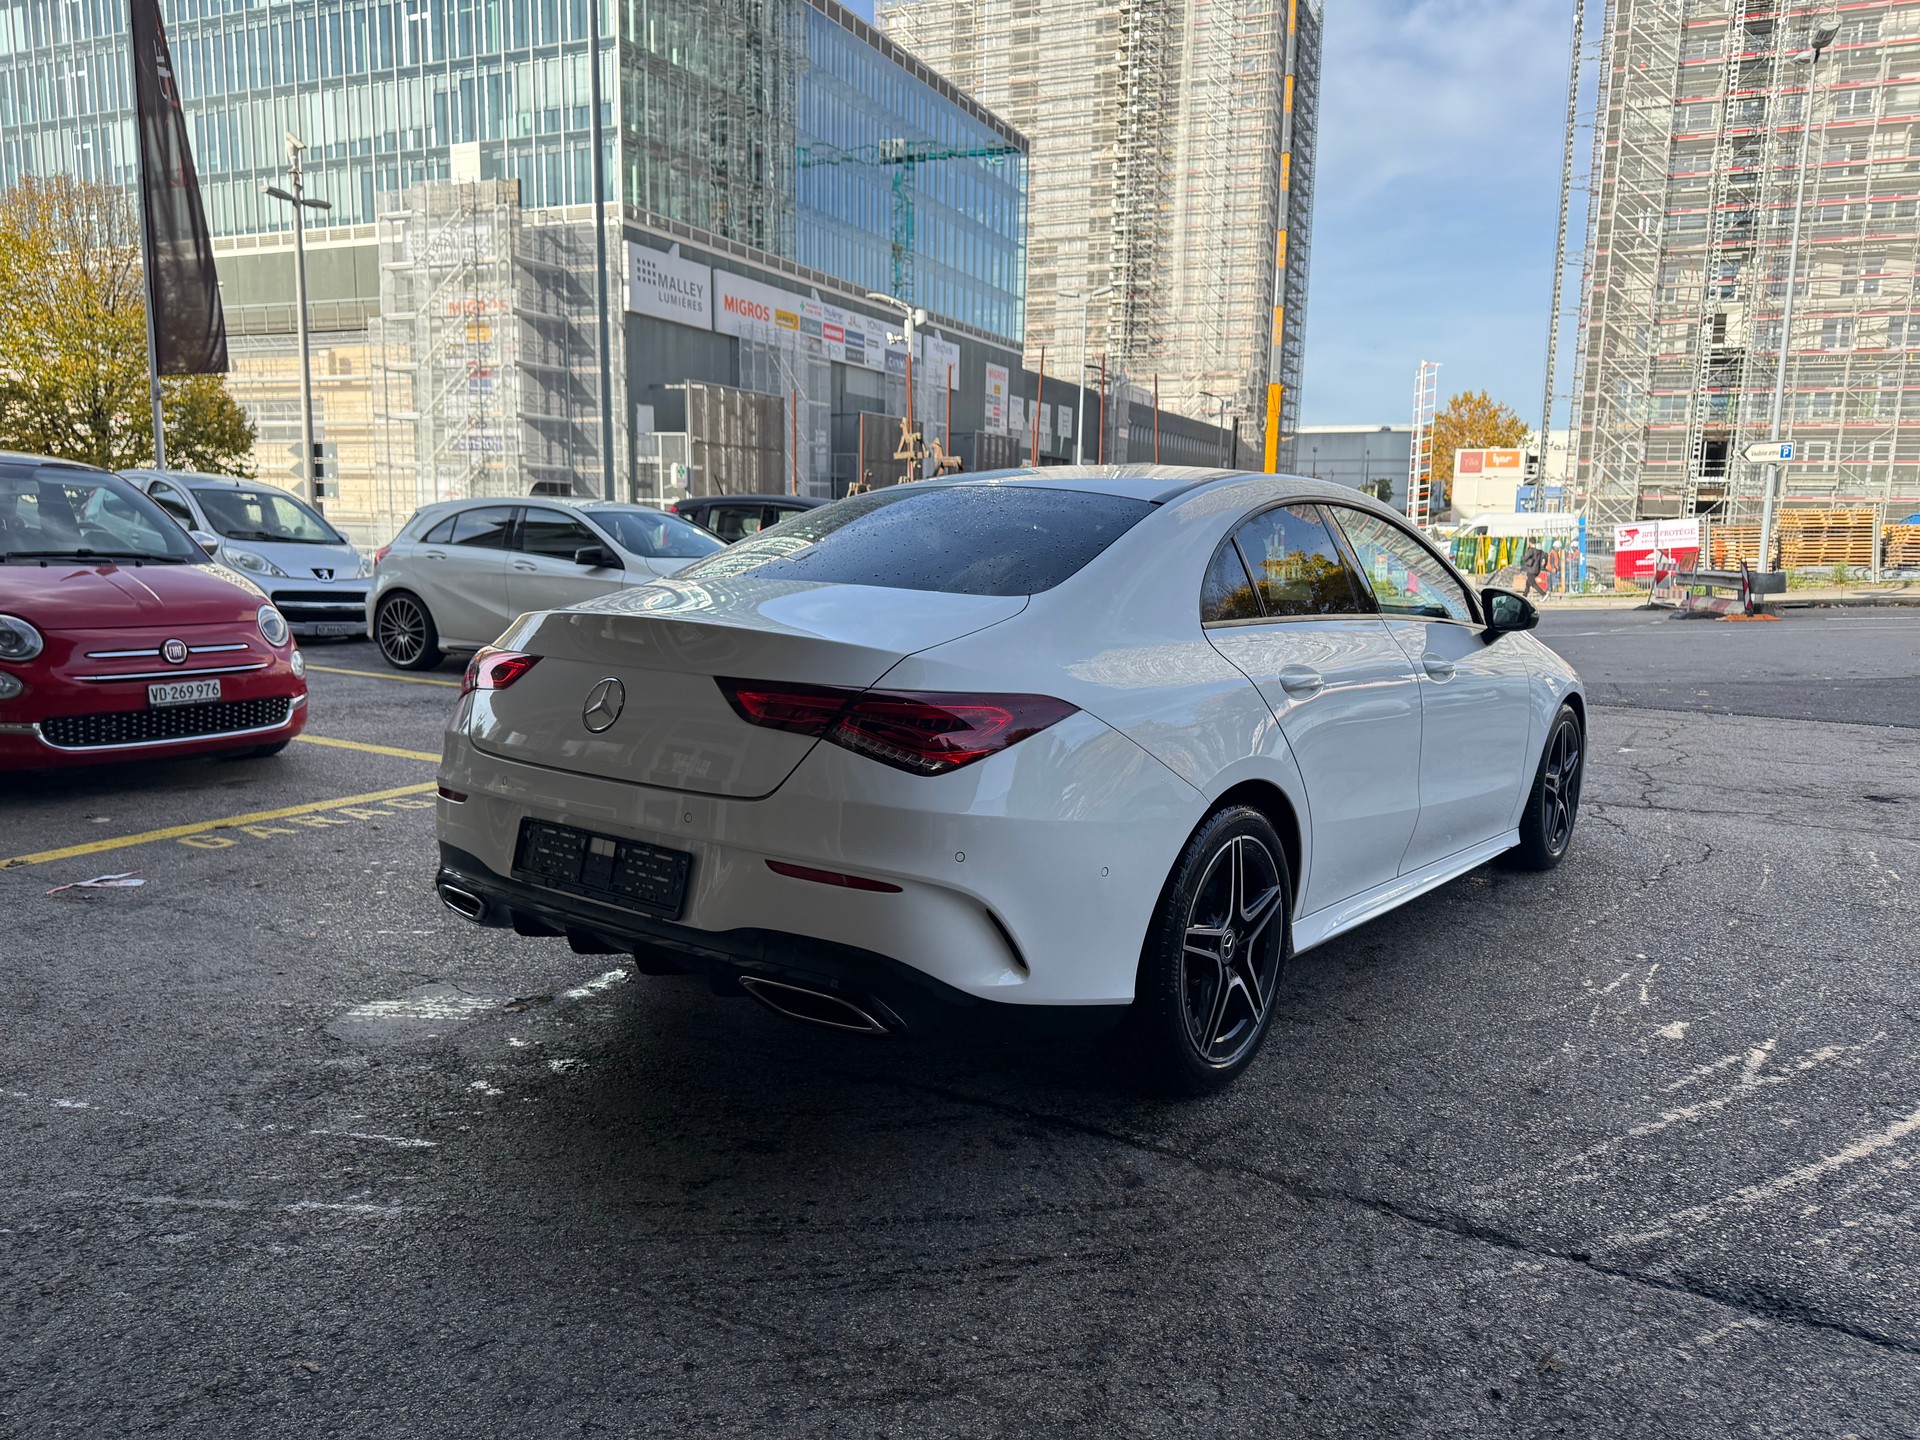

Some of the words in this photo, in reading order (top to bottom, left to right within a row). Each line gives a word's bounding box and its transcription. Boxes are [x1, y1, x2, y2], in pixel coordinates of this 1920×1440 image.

[658, 273, 703, 298] MALLEY
[658, 291, 703, 313] LUMIÈRES
[724, 294, 770, 322] MIGROS
[169, 645, 182, 658] FIAT
[177, 793, 437, 850] GARAG
